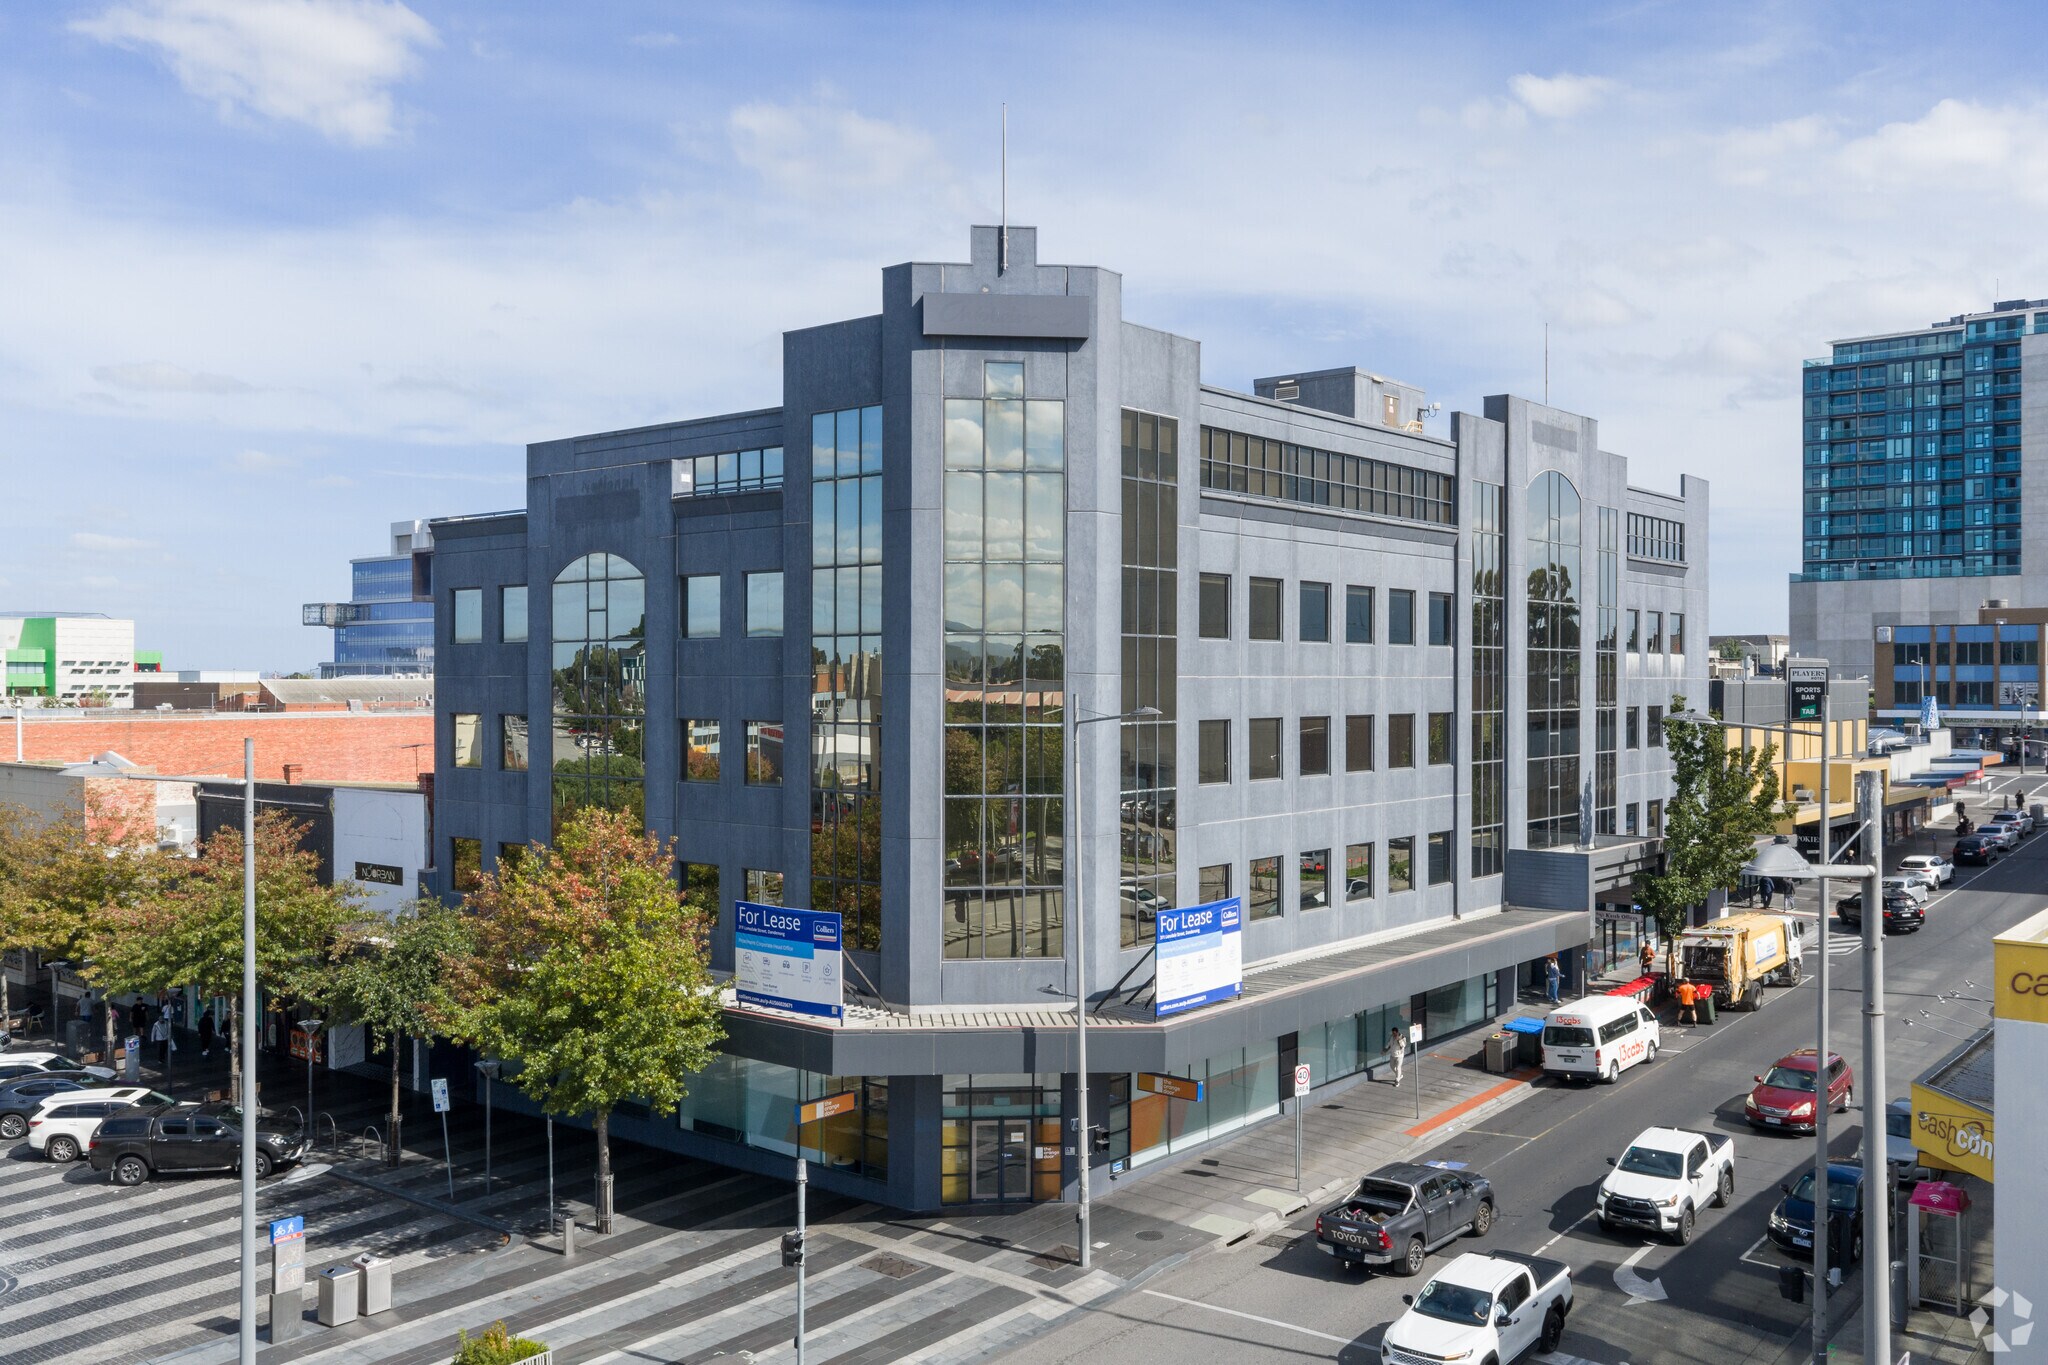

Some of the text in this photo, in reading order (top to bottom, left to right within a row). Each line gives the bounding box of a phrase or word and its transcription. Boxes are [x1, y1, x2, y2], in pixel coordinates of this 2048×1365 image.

[739, 906, 801, 931] For Lease
[1223, 911, 1237, 919] Colliers
[1160, 910, 1213, 932] For Lease
[815, 924, 835, 934] Colliers
[1556, 1015, 1581, 1025] 13cabs
[1619, 1039, 1645, 1063] 13cabs
[1297, 1070, 1308, 1080] 40
[1296, 1085, 1309, 1093] AREA
[824, 1103, 840, 1112] orange
[1331, 1230, 1370, 1246] TOYOTA
